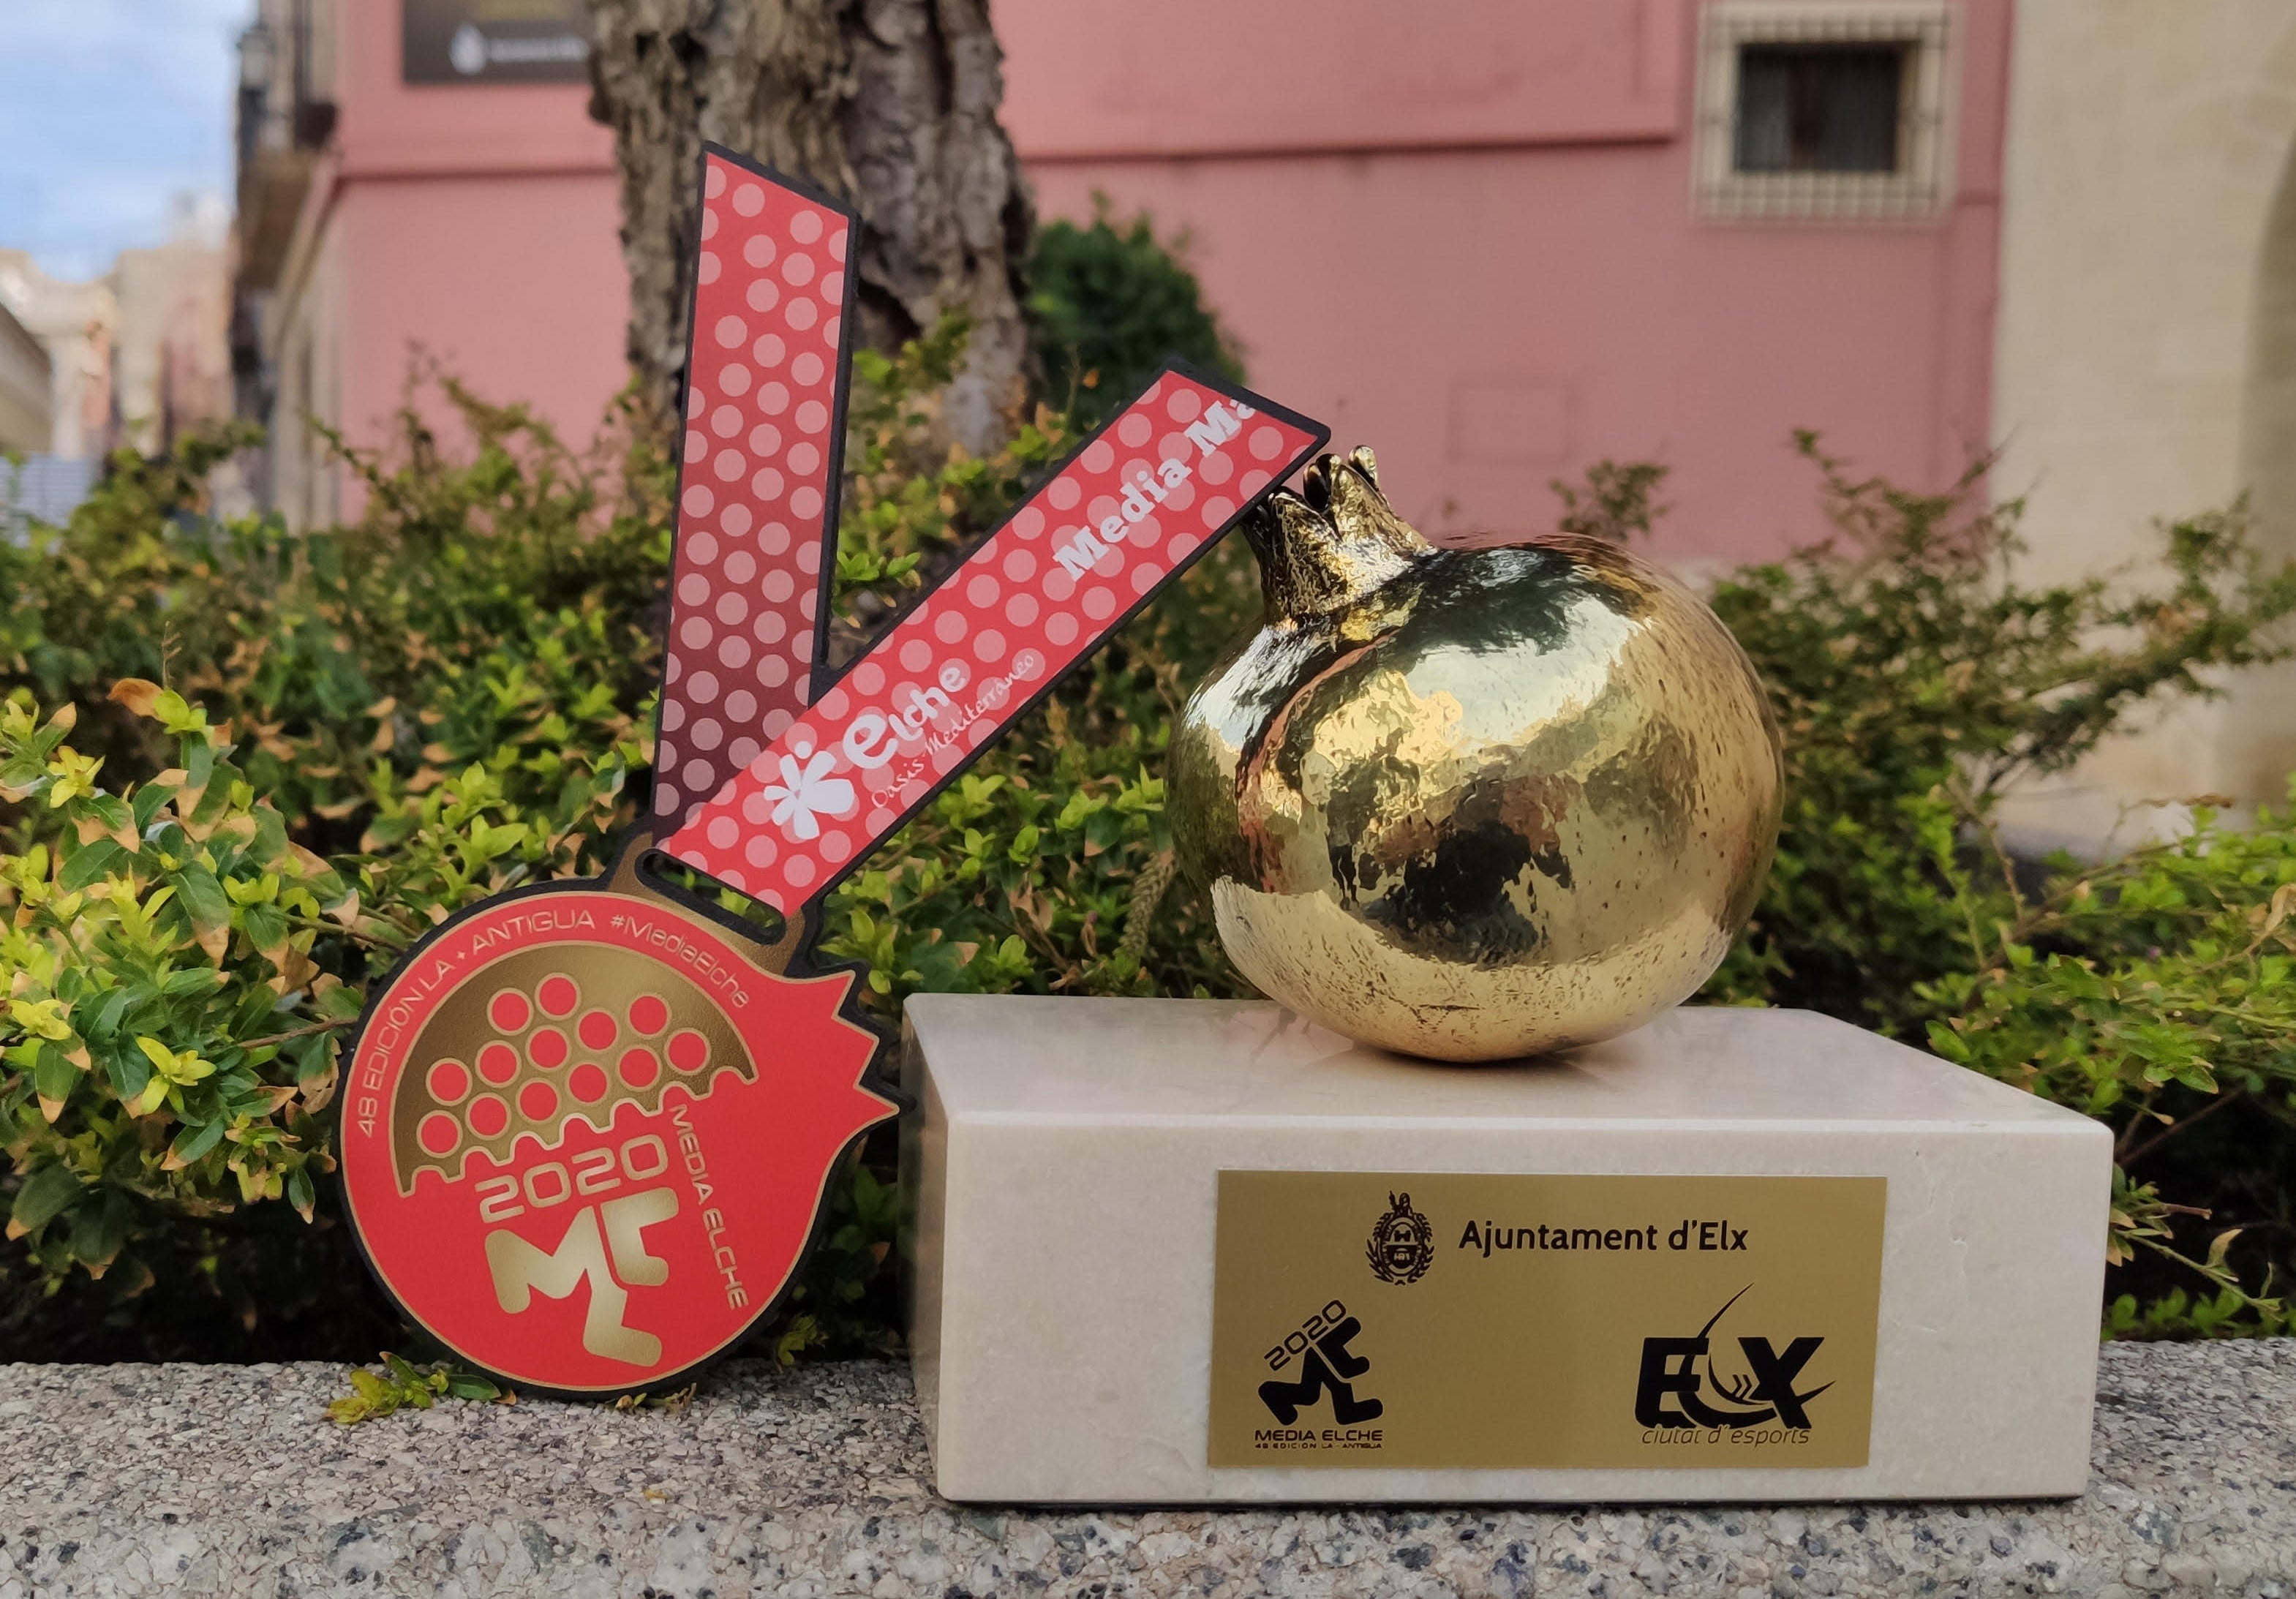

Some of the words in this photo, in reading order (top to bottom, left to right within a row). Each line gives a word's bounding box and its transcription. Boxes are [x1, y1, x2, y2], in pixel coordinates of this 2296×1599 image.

[1053, 458, 1193, 582] Media
[871, 759, 925, 808] Oasis
[472, 909, 595, 955] ANTIGUA
[418, 959, 456, 991] LA
[610, 914, 750, 1009] #MediaElche
[363, 986, 424, 1091] EDICIÓN
[358, 1096, 377, 1137] 48
[475, 1134, 669, 1224] 2020
[669, 1104, 714, 1206] MEDIA
[702, 1208, 750, 1312] ELCHE
[1458, 1220, 1658, 1258] Ajuntament
[1668, 1219, 1750, 1251] d'Elx
[1263, 1299, 1347, 1372] 2020
[1254, 1429, 1316, 1442] MEDIA
[1321, 1429, 1383, 1442] ELCHE
[1641, 1426, 1703, 1445] ciutat
